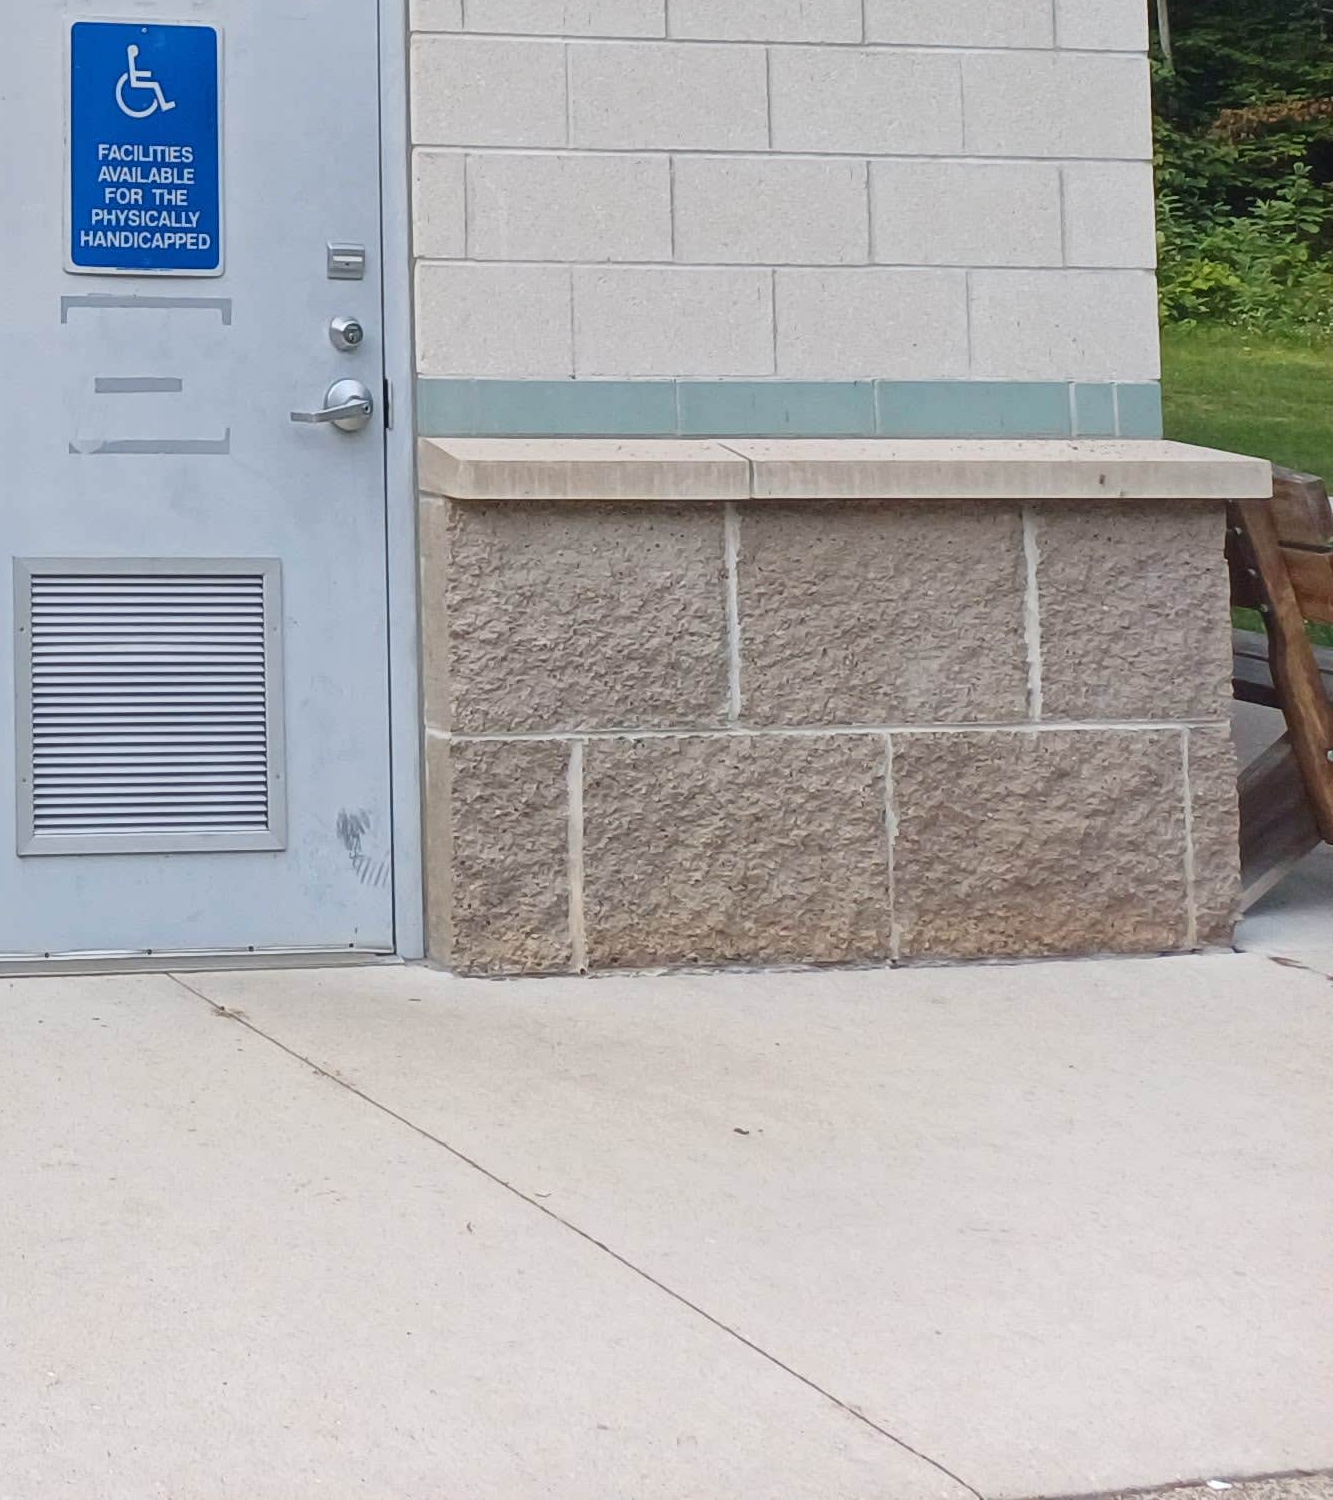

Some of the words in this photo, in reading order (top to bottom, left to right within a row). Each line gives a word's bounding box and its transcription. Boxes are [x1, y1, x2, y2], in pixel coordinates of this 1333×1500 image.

[98, 144, 193, 163] FACILITIES
[98, 166, 195, 185] AVAILABLE
[104, 187, 143, 205] FOR
[152, 188, 188, 206] THE
[91, 209, 200, 228] PHYSICALLY
[80, 231, 211, 250] HANDICAPPED
